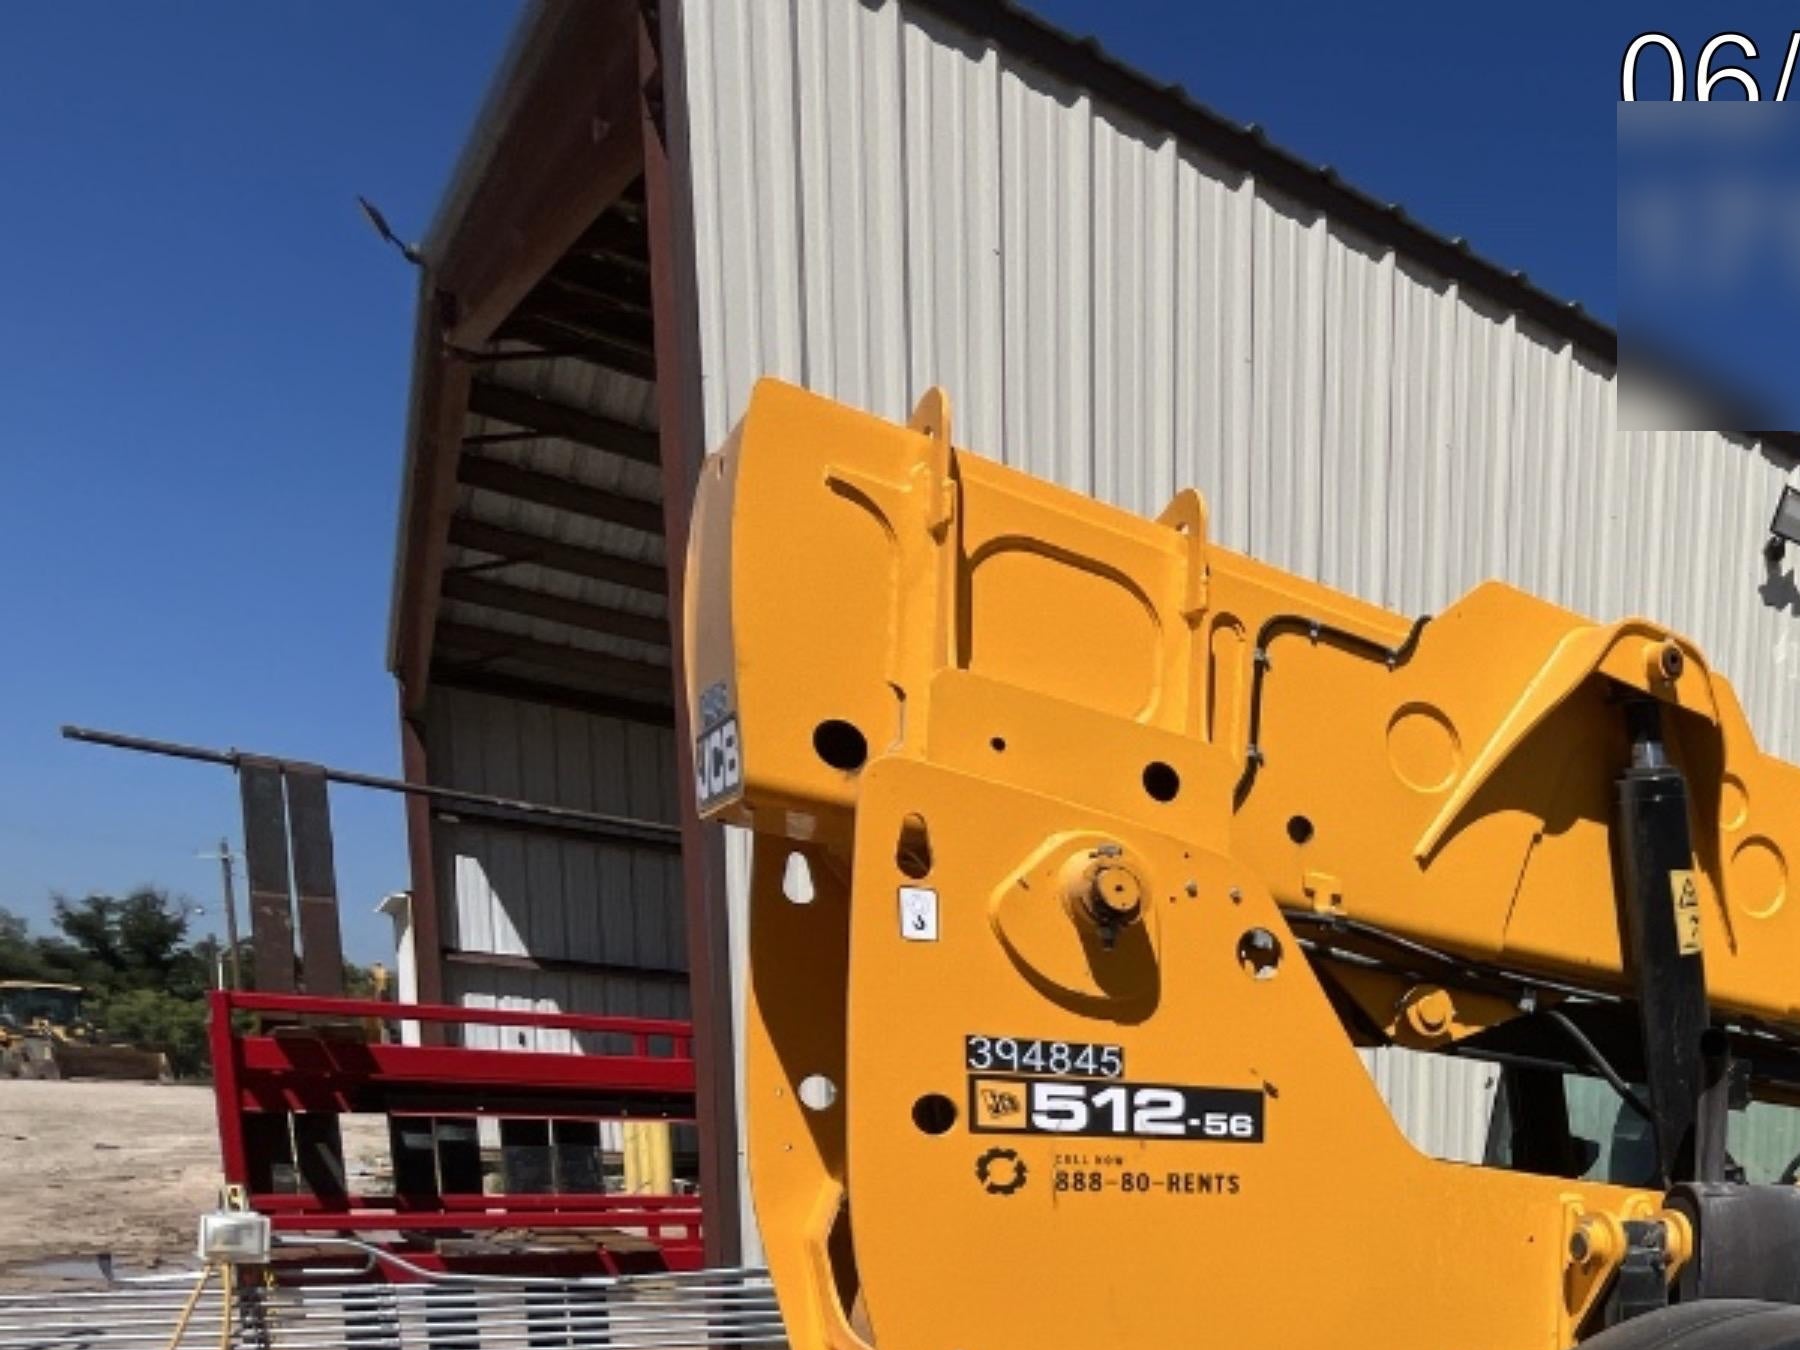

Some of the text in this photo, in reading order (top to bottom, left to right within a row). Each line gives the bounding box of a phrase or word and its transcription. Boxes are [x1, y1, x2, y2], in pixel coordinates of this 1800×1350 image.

[696, 718, 740, 800] JCB
[967, 1035, 1122, 1077] 394845
[1031, 1081, 1254, 1137] 512-56
[1055, 1170, 1241, 1195] 888-80-RENTS
